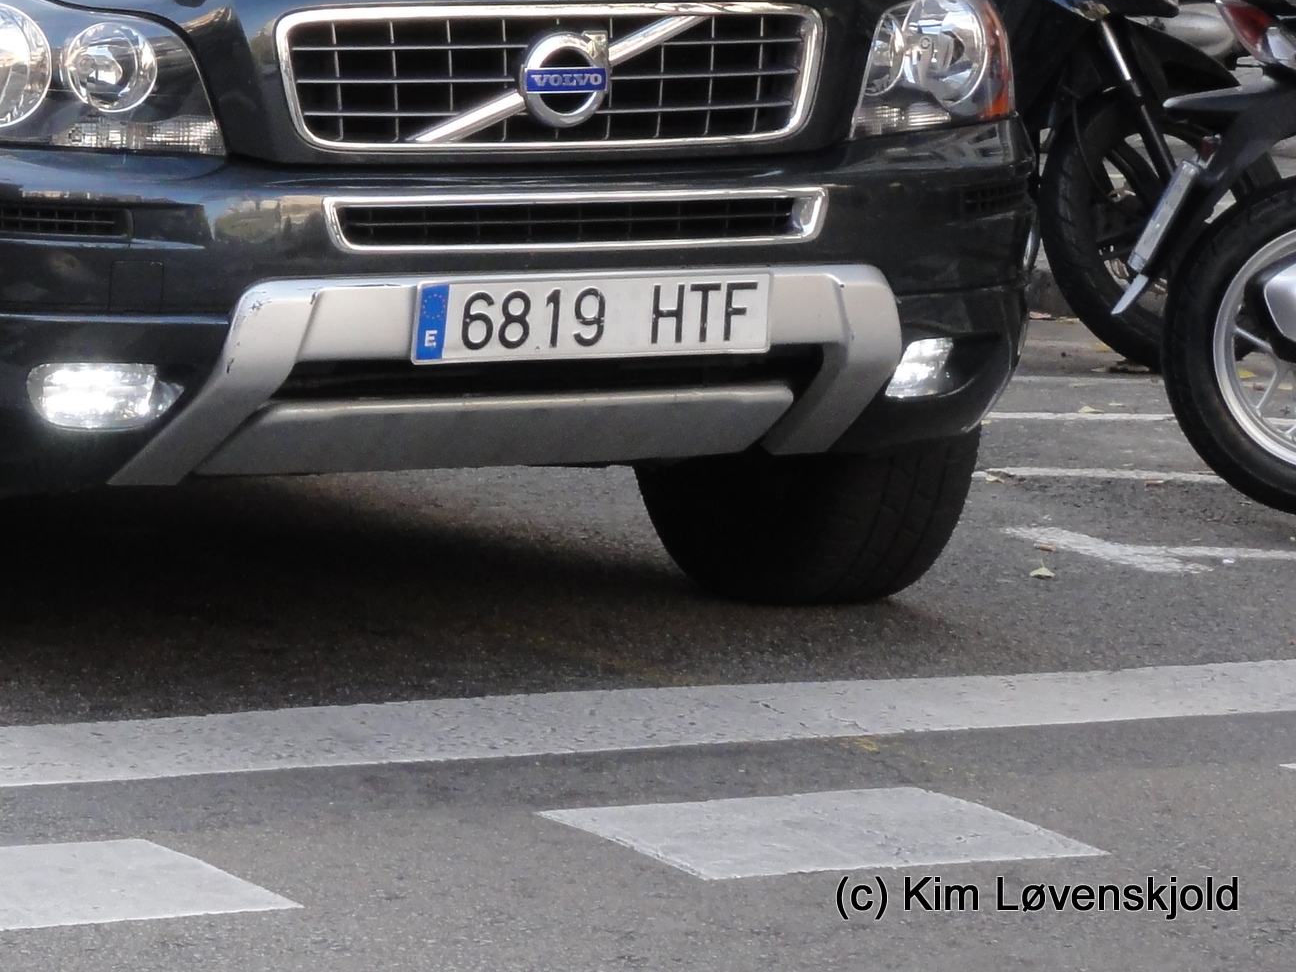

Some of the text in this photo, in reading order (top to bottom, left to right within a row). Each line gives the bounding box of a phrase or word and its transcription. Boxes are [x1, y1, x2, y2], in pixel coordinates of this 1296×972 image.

[530, 73, 603, 86] VOLVO
[424, 280, 759, 351] E 6819 HTF
